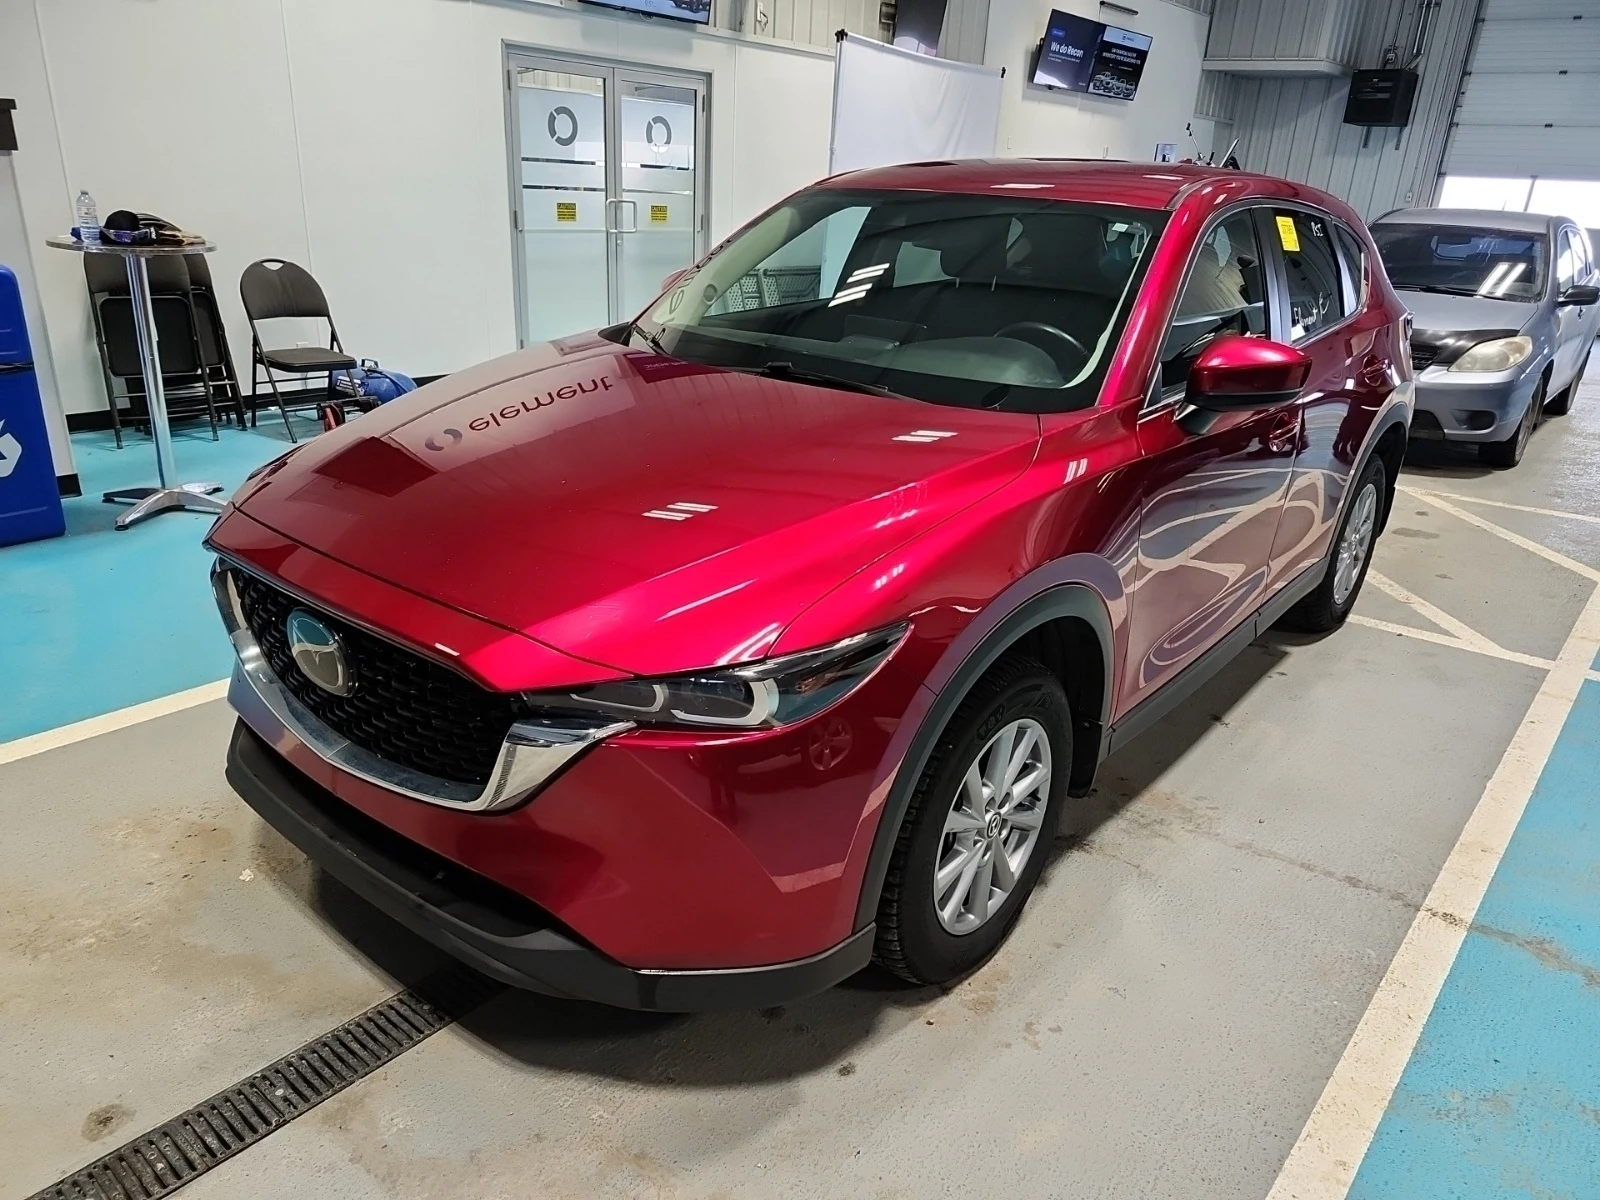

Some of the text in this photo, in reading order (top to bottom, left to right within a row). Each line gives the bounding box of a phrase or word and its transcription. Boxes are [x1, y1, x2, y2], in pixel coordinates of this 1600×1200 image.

[1051, 42, 1060, 52] We
[1060, 44, 1068, 54] do
[1067, 46, 1084, 58] Recon
